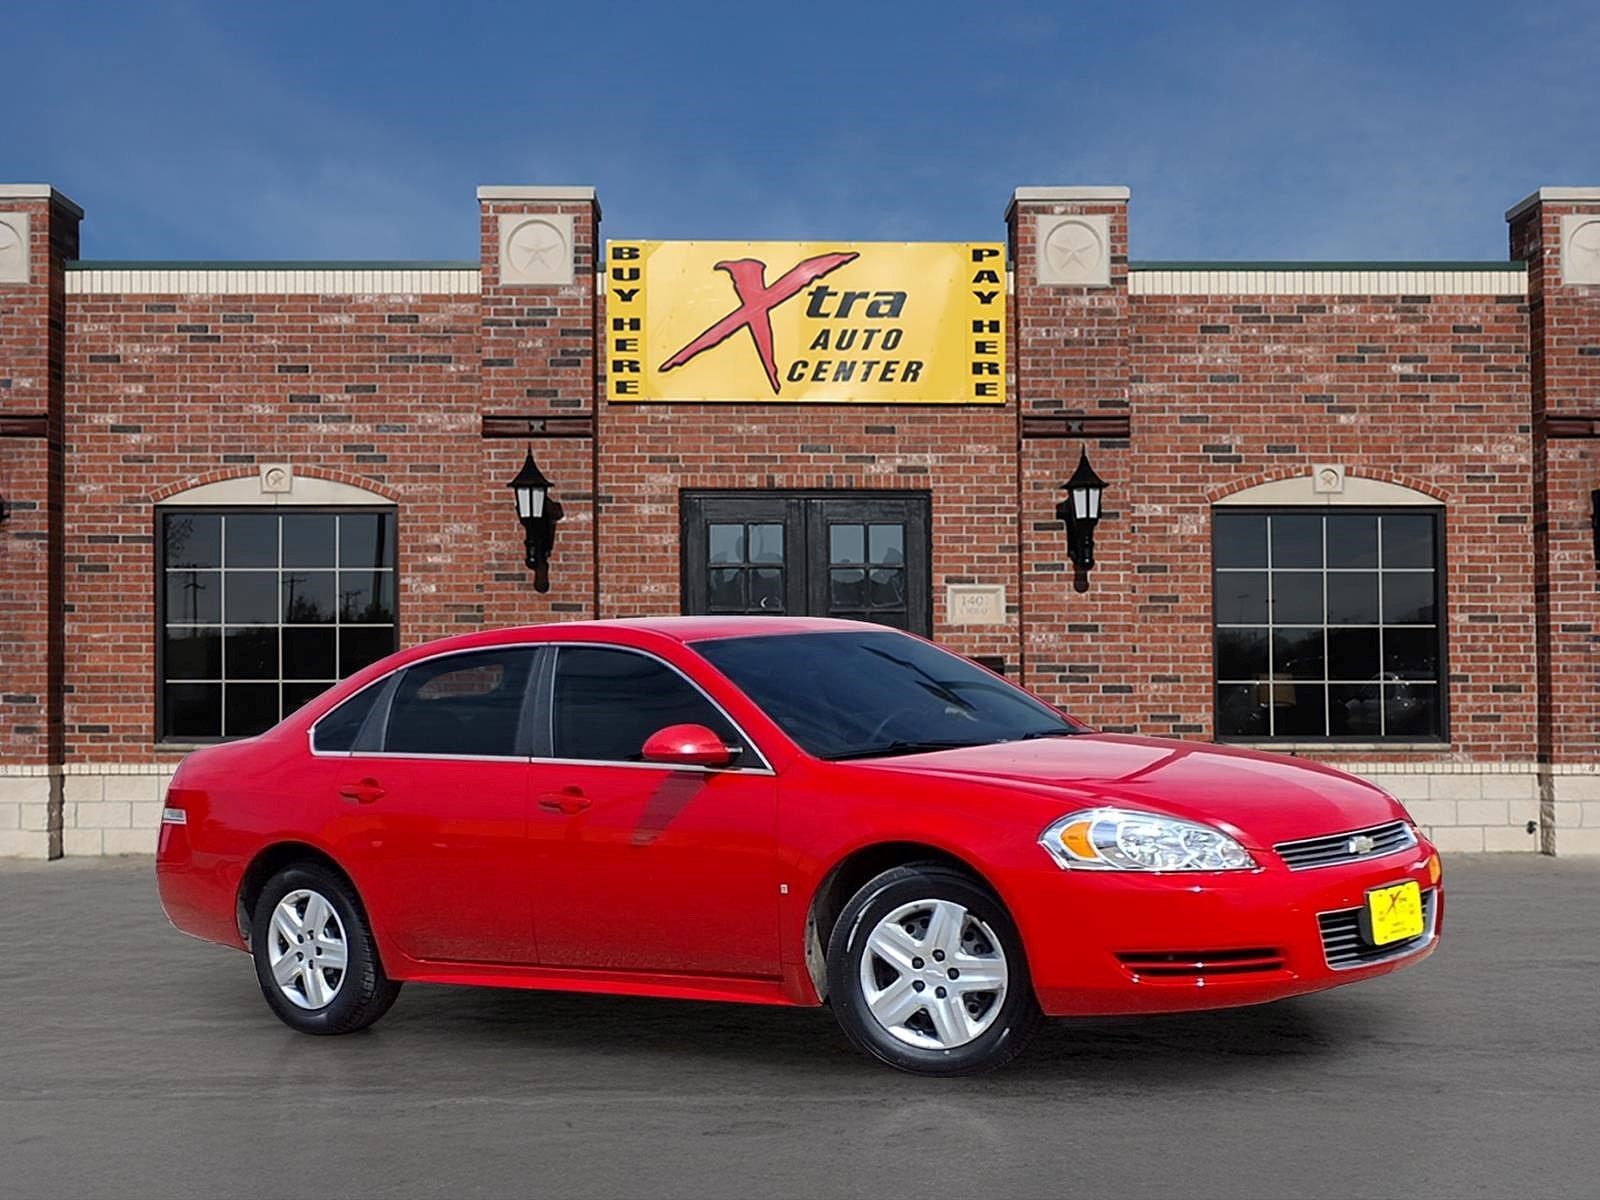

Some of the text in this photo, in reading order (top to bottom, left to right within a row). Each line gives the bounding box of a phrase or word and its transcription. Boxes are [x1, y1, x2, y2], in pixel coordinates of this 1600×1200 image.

[612, 247, 641, 395] BUY HERE
[658, 251, 908, 395] Xtra
[786, 360, 924, 382] CENTER
[809, 328, 904, 351] AUTO
[972, 249, 1000, 397] PAY HERE
